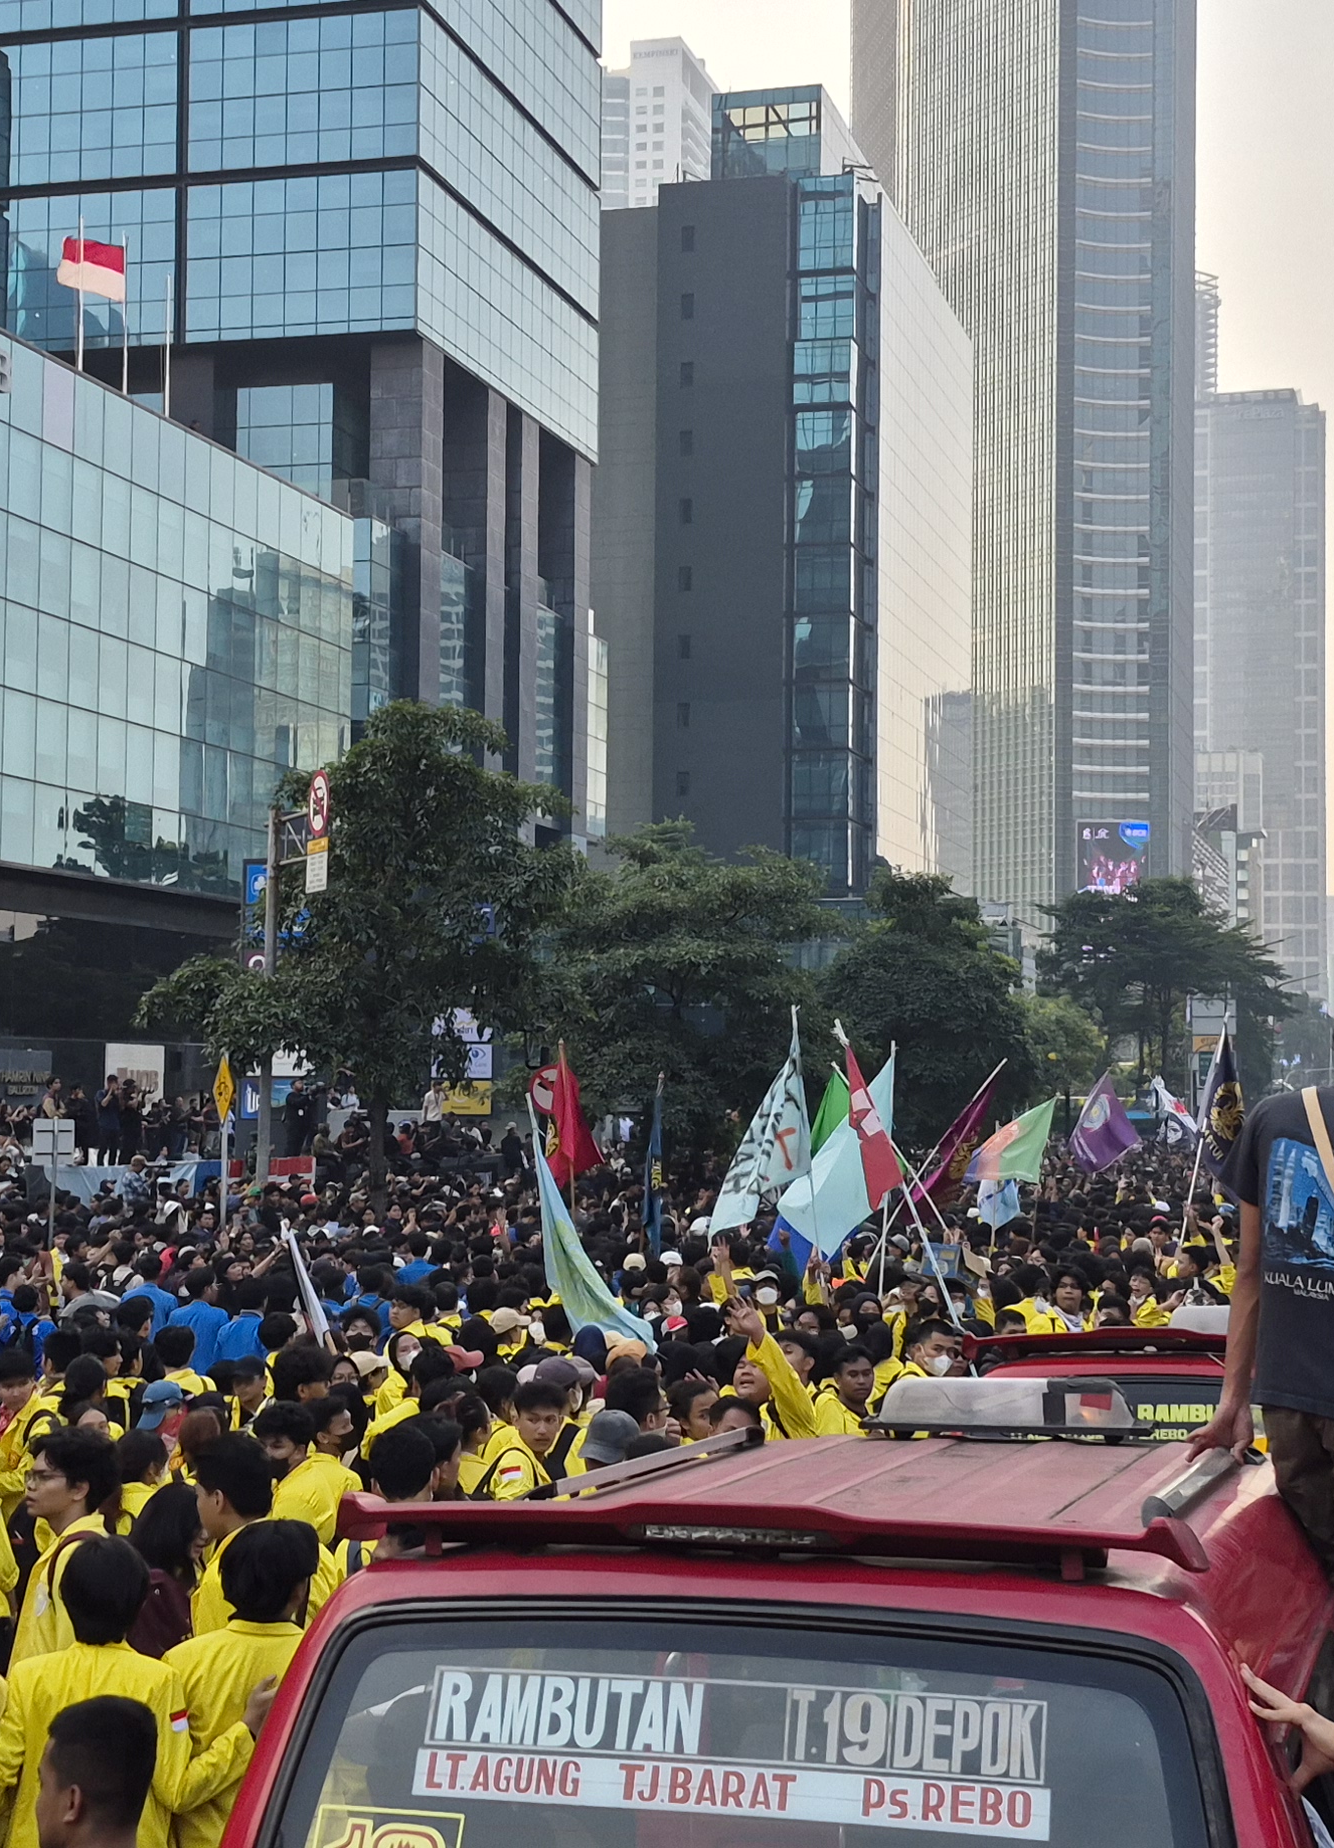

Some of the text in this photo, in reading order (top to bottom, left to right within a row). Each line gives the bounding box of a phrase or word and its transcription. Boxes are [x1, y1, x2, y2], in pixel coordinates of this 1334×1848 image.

[434, 1671, 1039, 1779] RAMBUTAN T.19 DEPOK
[425, 1751, 1033, 1829] LT.AGUNG TJ.BARAT Ps.REBO
